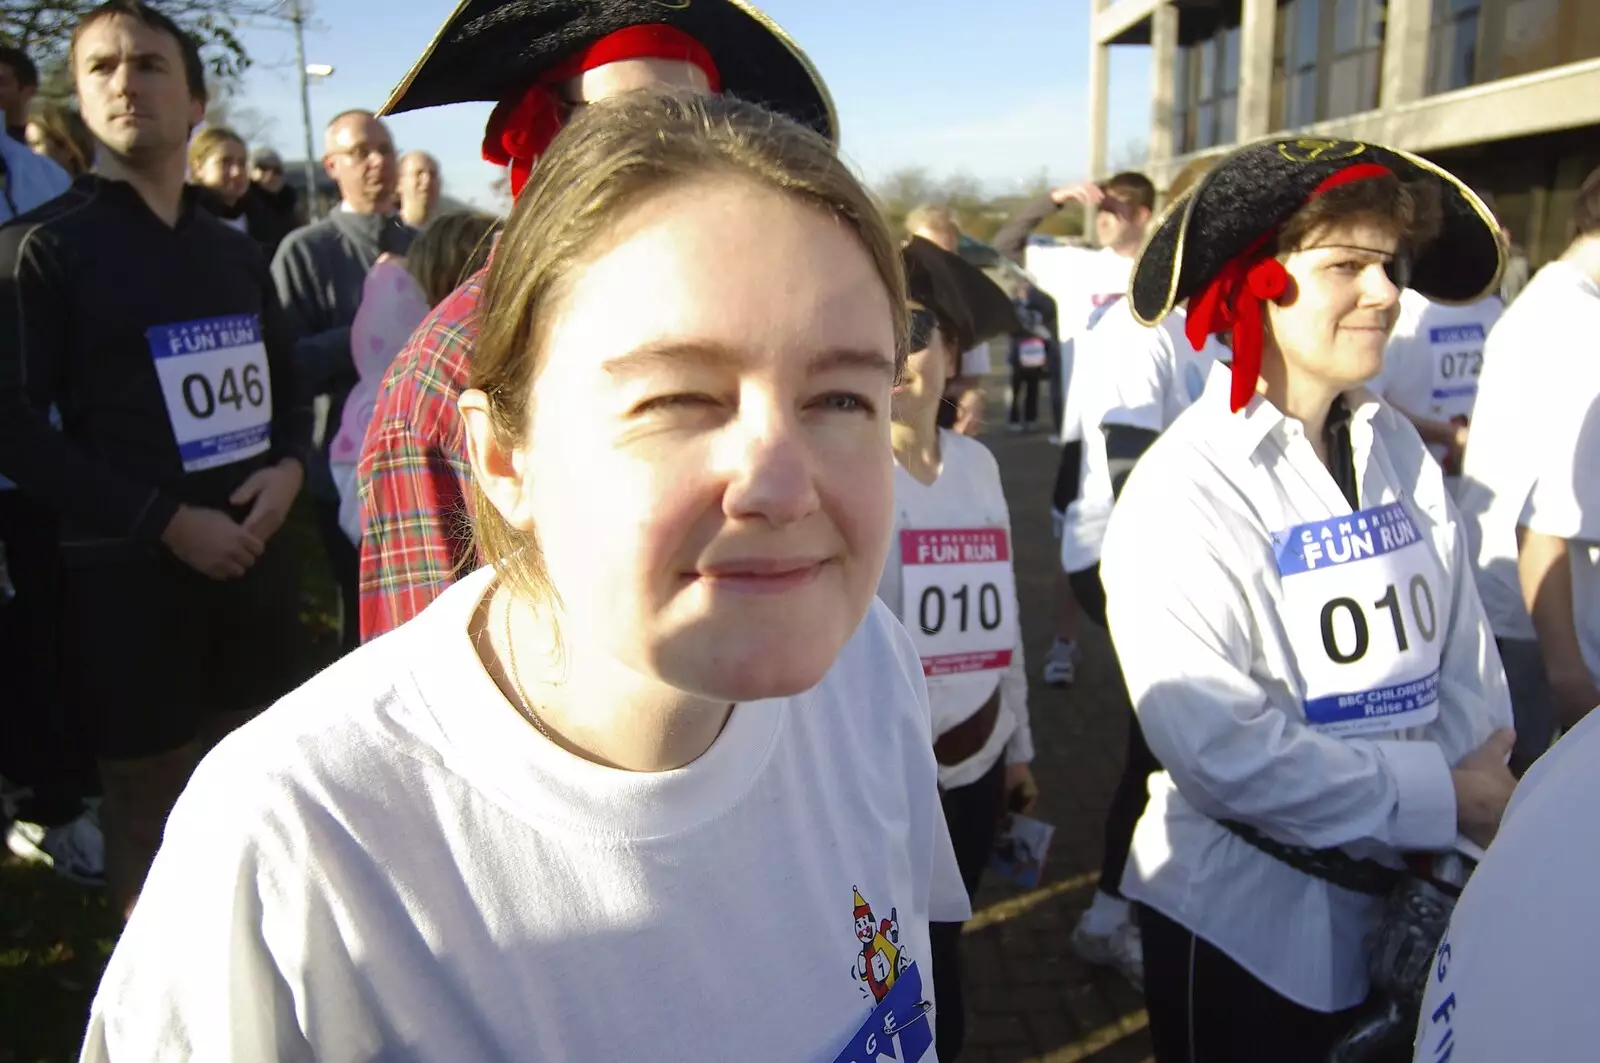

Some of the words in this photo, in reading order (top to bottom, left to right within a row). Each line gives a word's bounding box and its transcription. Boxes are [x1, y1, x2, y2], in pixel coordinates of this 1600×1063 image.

[169, 333, 216, 354] FUN
[220, 328, 254, 347] RUN
[1441, 351, 1484, 379] 072
[182, 363, 264, 419] 046
[1301, 507, 1406, 543] CAMBRIDGE
[918, 544, 959, 563] FUN
[963, 543, 997, 561] RUN
[1302, 531, 1375, 569] FUN
[1379, 518, 1416, 550] RUN
[919, 582, 1002, 636] 010
[1320, 573, 1436, 665] 010
[1338, 693, 1366, 709] BBC
[1367, 680, 1426, 702] CHILDREN
[1364, 701, 1402, 717] Raise
[1405, 700, 1415, 710] a
